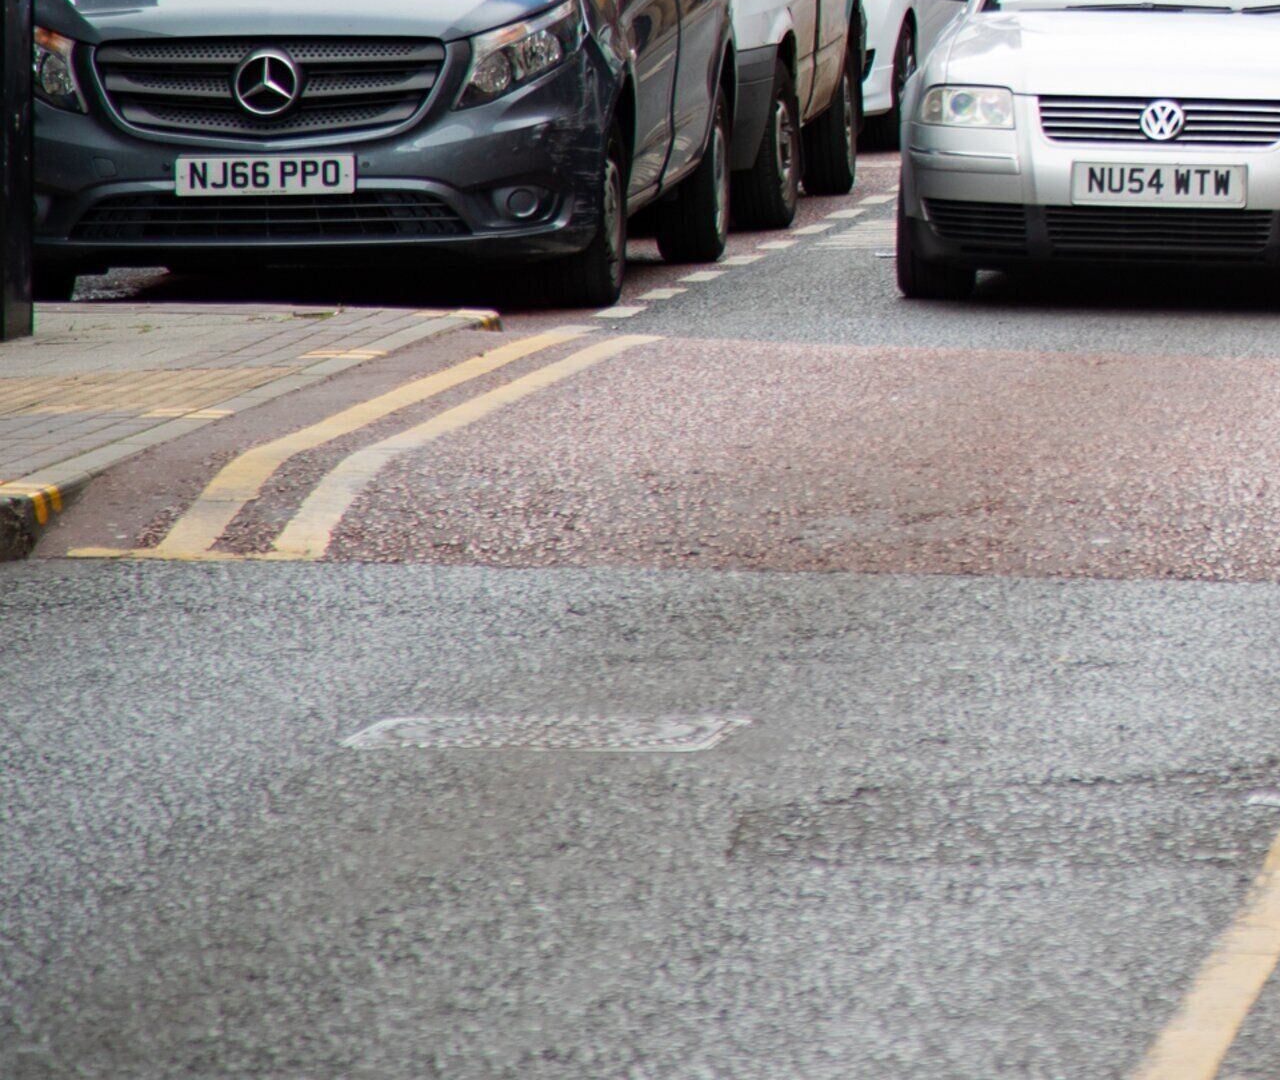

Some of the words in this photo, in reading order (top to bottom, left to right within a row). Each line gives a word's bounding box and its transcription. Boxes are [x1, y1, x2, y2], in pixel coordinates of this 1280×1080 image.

[189, 160, 270, 190] NJ66
[279, 159, 341, 189] PPO
[1087, 166, 1164, 196] NU54
[1174, 168, 1232, 197] WTW
